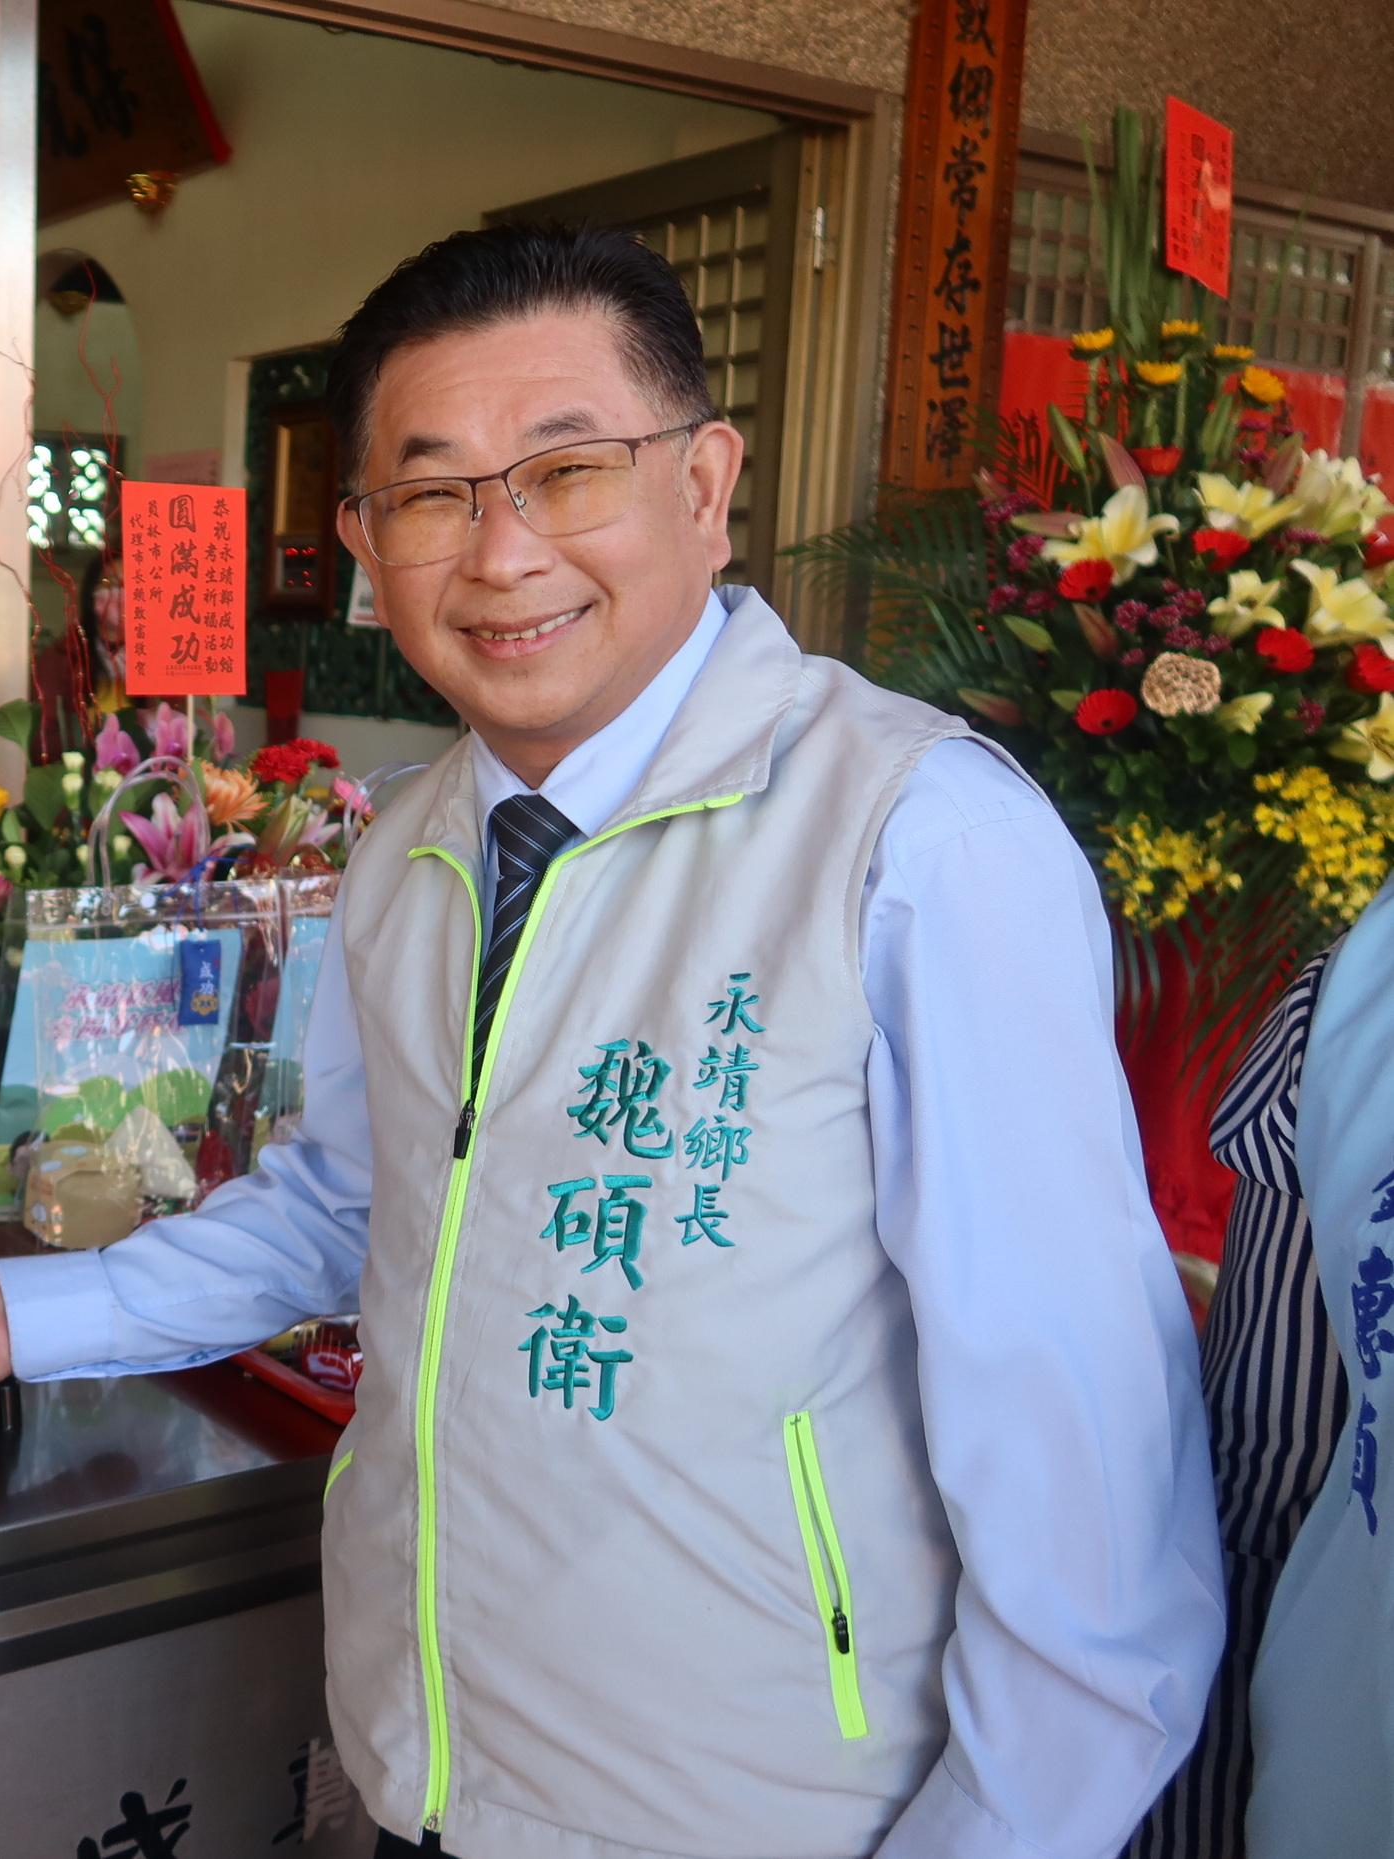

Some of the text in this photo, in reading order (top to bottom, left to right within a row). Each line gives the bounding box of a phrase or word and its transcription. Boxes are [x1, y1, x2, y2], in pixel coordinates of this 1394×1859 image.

[169, 494, 201, 664] 圓滿成功
[518, 1037, 675, 1422] 魏碩衛
[674, 972, 767, 1248] 永靖鄉長
